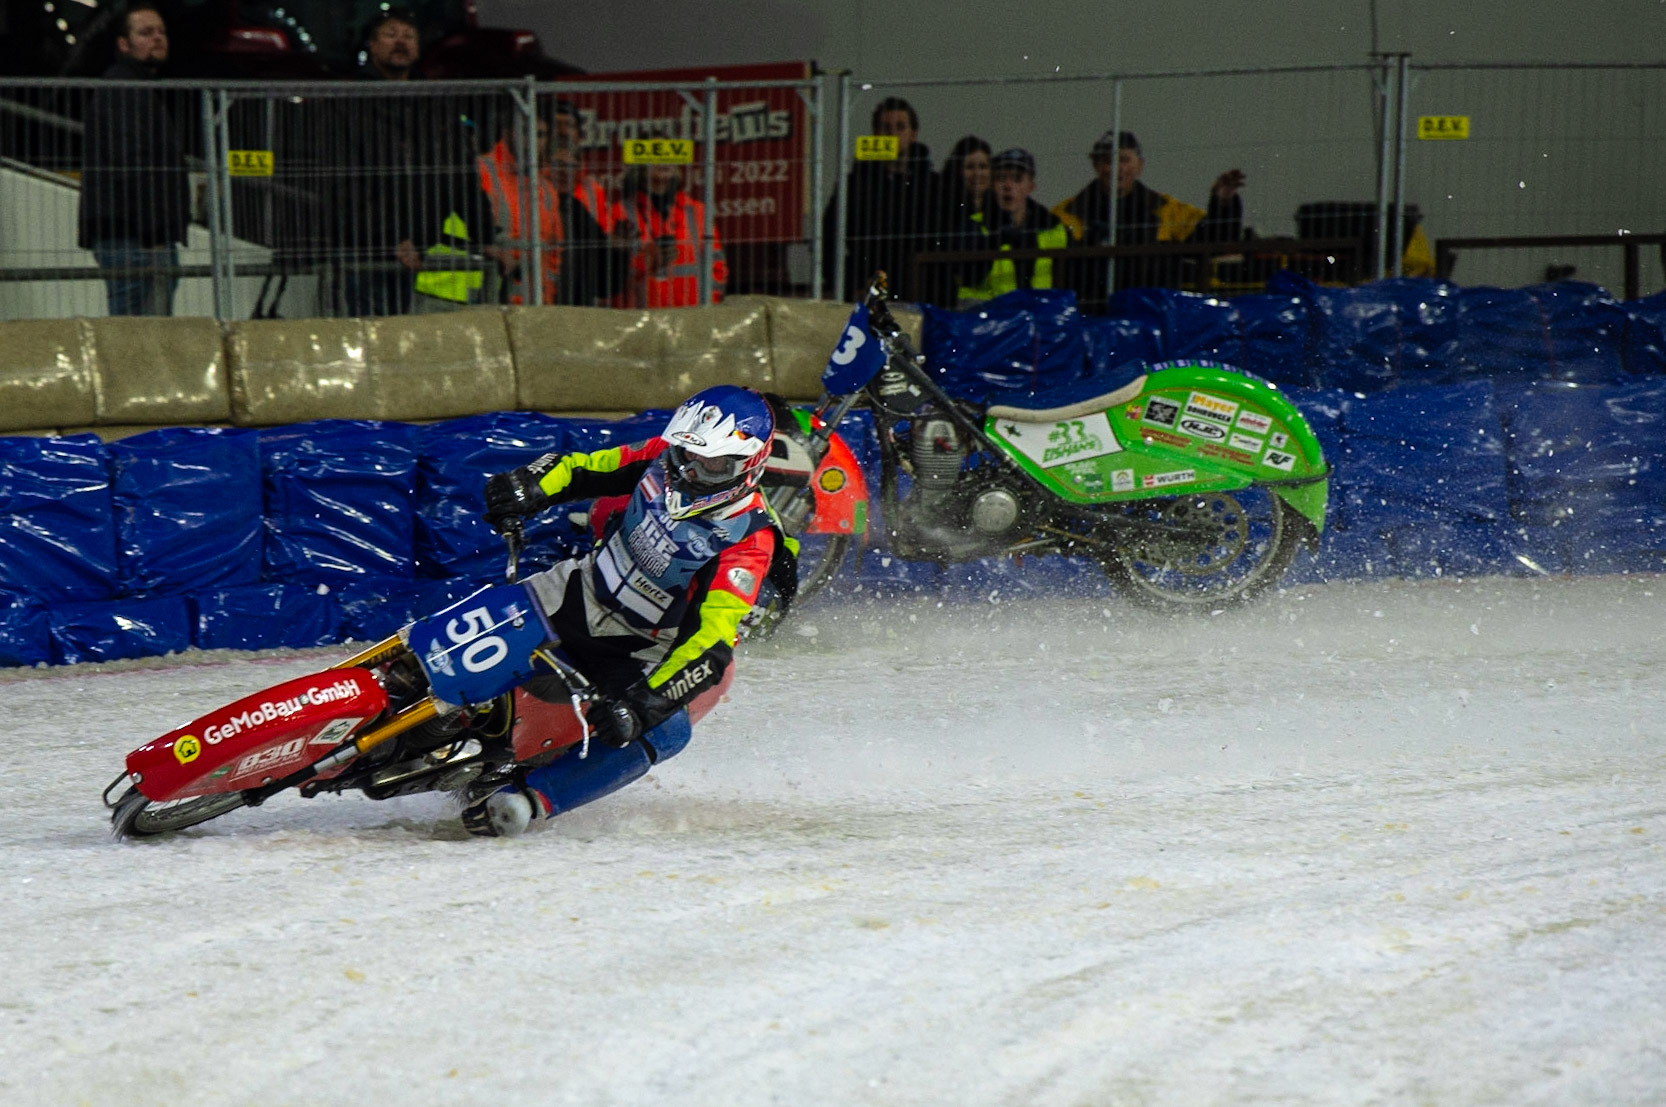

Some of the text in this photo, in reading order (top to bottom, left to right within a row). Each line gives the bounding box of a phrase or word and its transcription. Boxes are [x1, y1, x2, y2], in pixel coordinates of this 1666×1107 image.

[632, 143, 688, 156] D.E.V.
[730, 159, 789, 183] 2022
[713, 197, 776, 217] ssen
[639, 509, 680, 561] ICE
[635, 577, 668, 602] Hertz
[446, 606, 508, 673] 50
[203, 699, 302, 745] GeMoBau
[307, 679, 361, 707] GmbH
